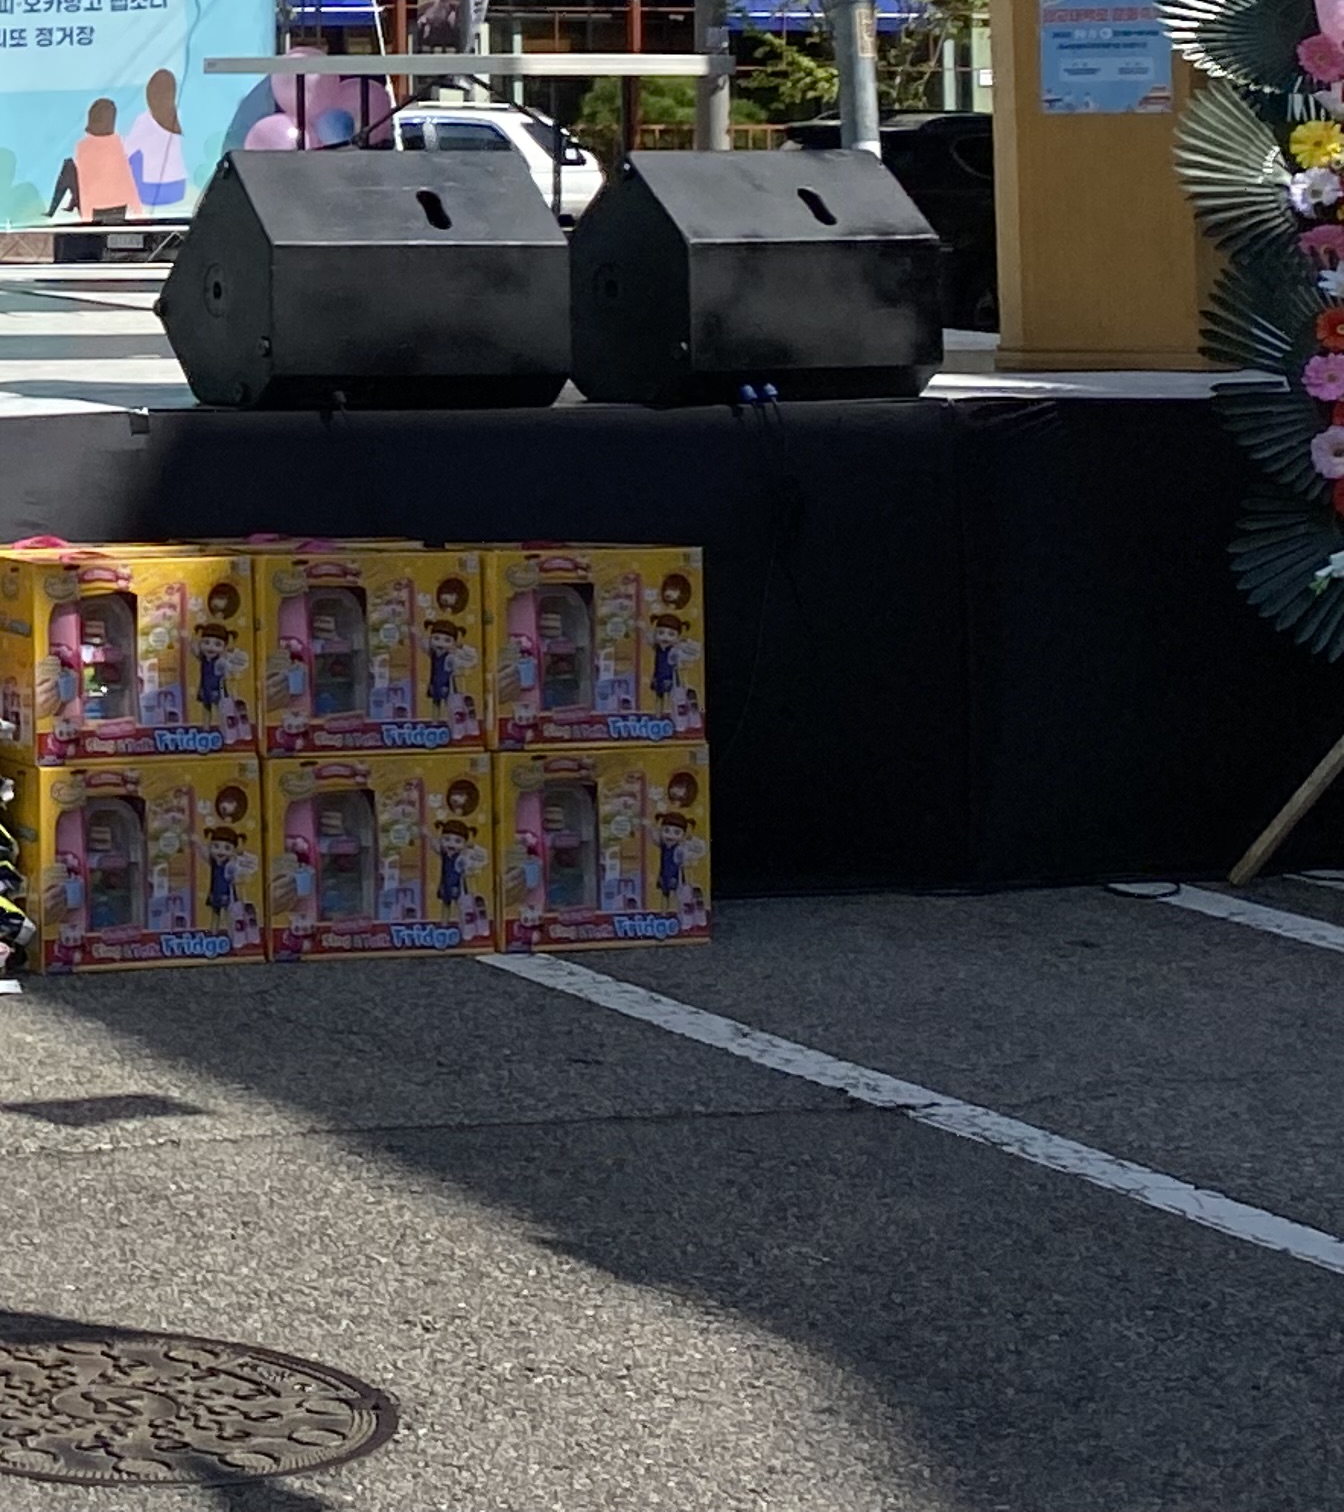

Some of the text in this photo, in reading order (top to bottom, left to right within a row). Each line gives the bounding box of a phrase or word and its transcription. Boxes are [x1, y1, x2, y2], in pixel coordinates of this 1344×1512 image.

[383, 722, 450, 749] Fridge
[607, 715, 674, 740] Fridge
[154, 728, 223, 755] Fridge
[391, 925, 459, 950] Fridge
[613, 915, 680, 940] Fridge
[160, 933, 229, 959] Fridge
